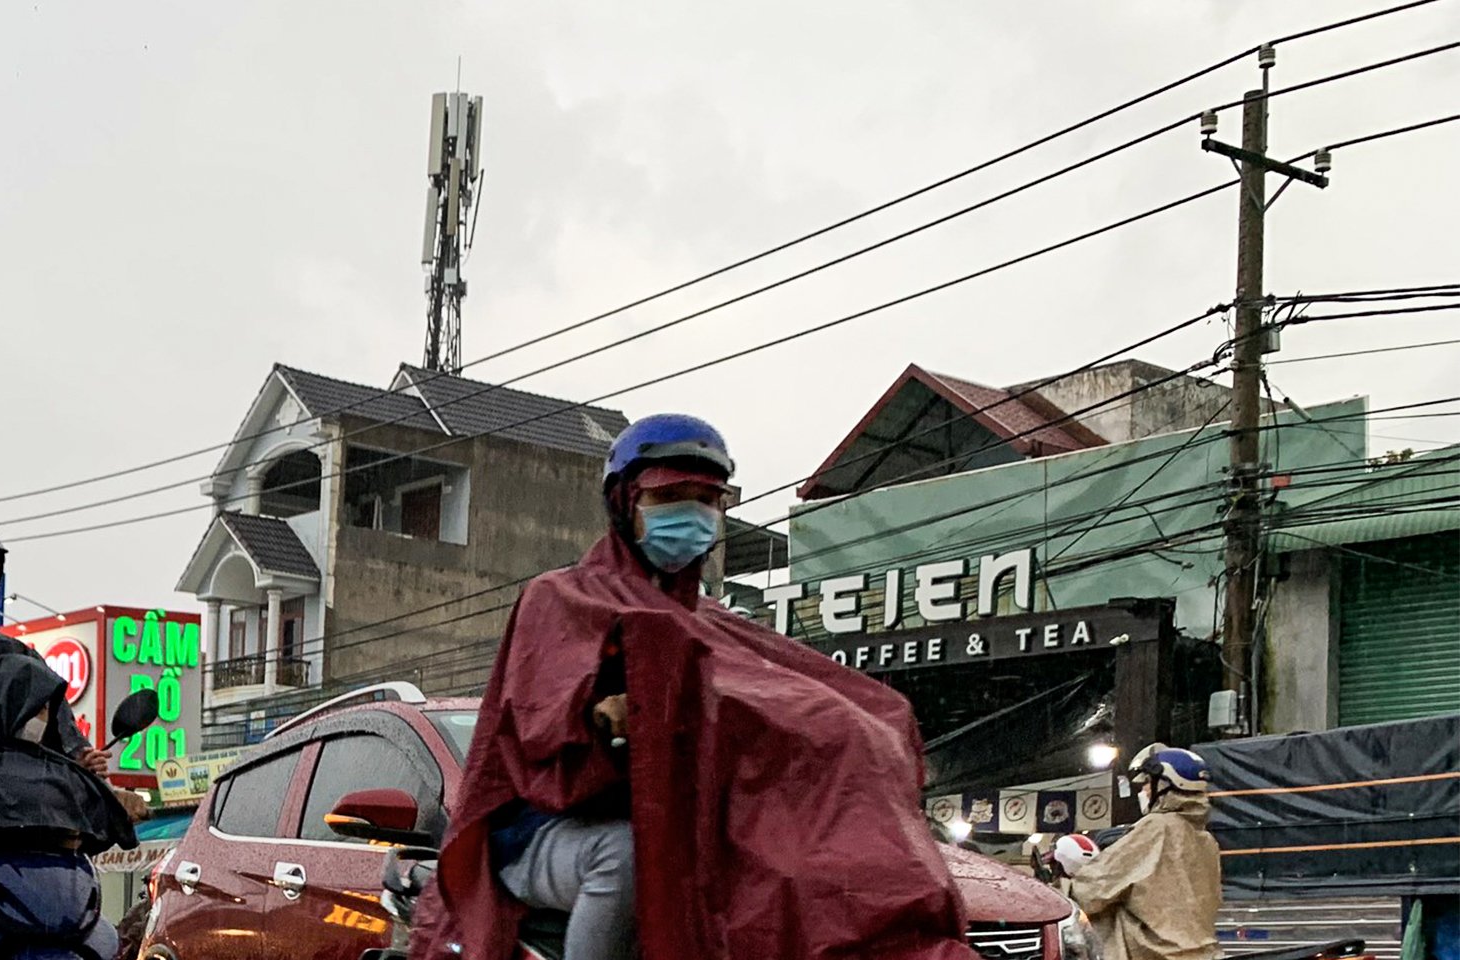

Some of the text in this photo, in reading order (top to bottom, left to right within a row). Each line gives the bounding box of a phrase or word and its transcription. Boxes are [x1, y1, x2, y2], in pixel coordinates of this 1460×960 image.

[113, 608, 199, 668] CẦM
[831, 620, 1091, 668] OFFEE & TEA
[120, 726, 186, 770] 201
